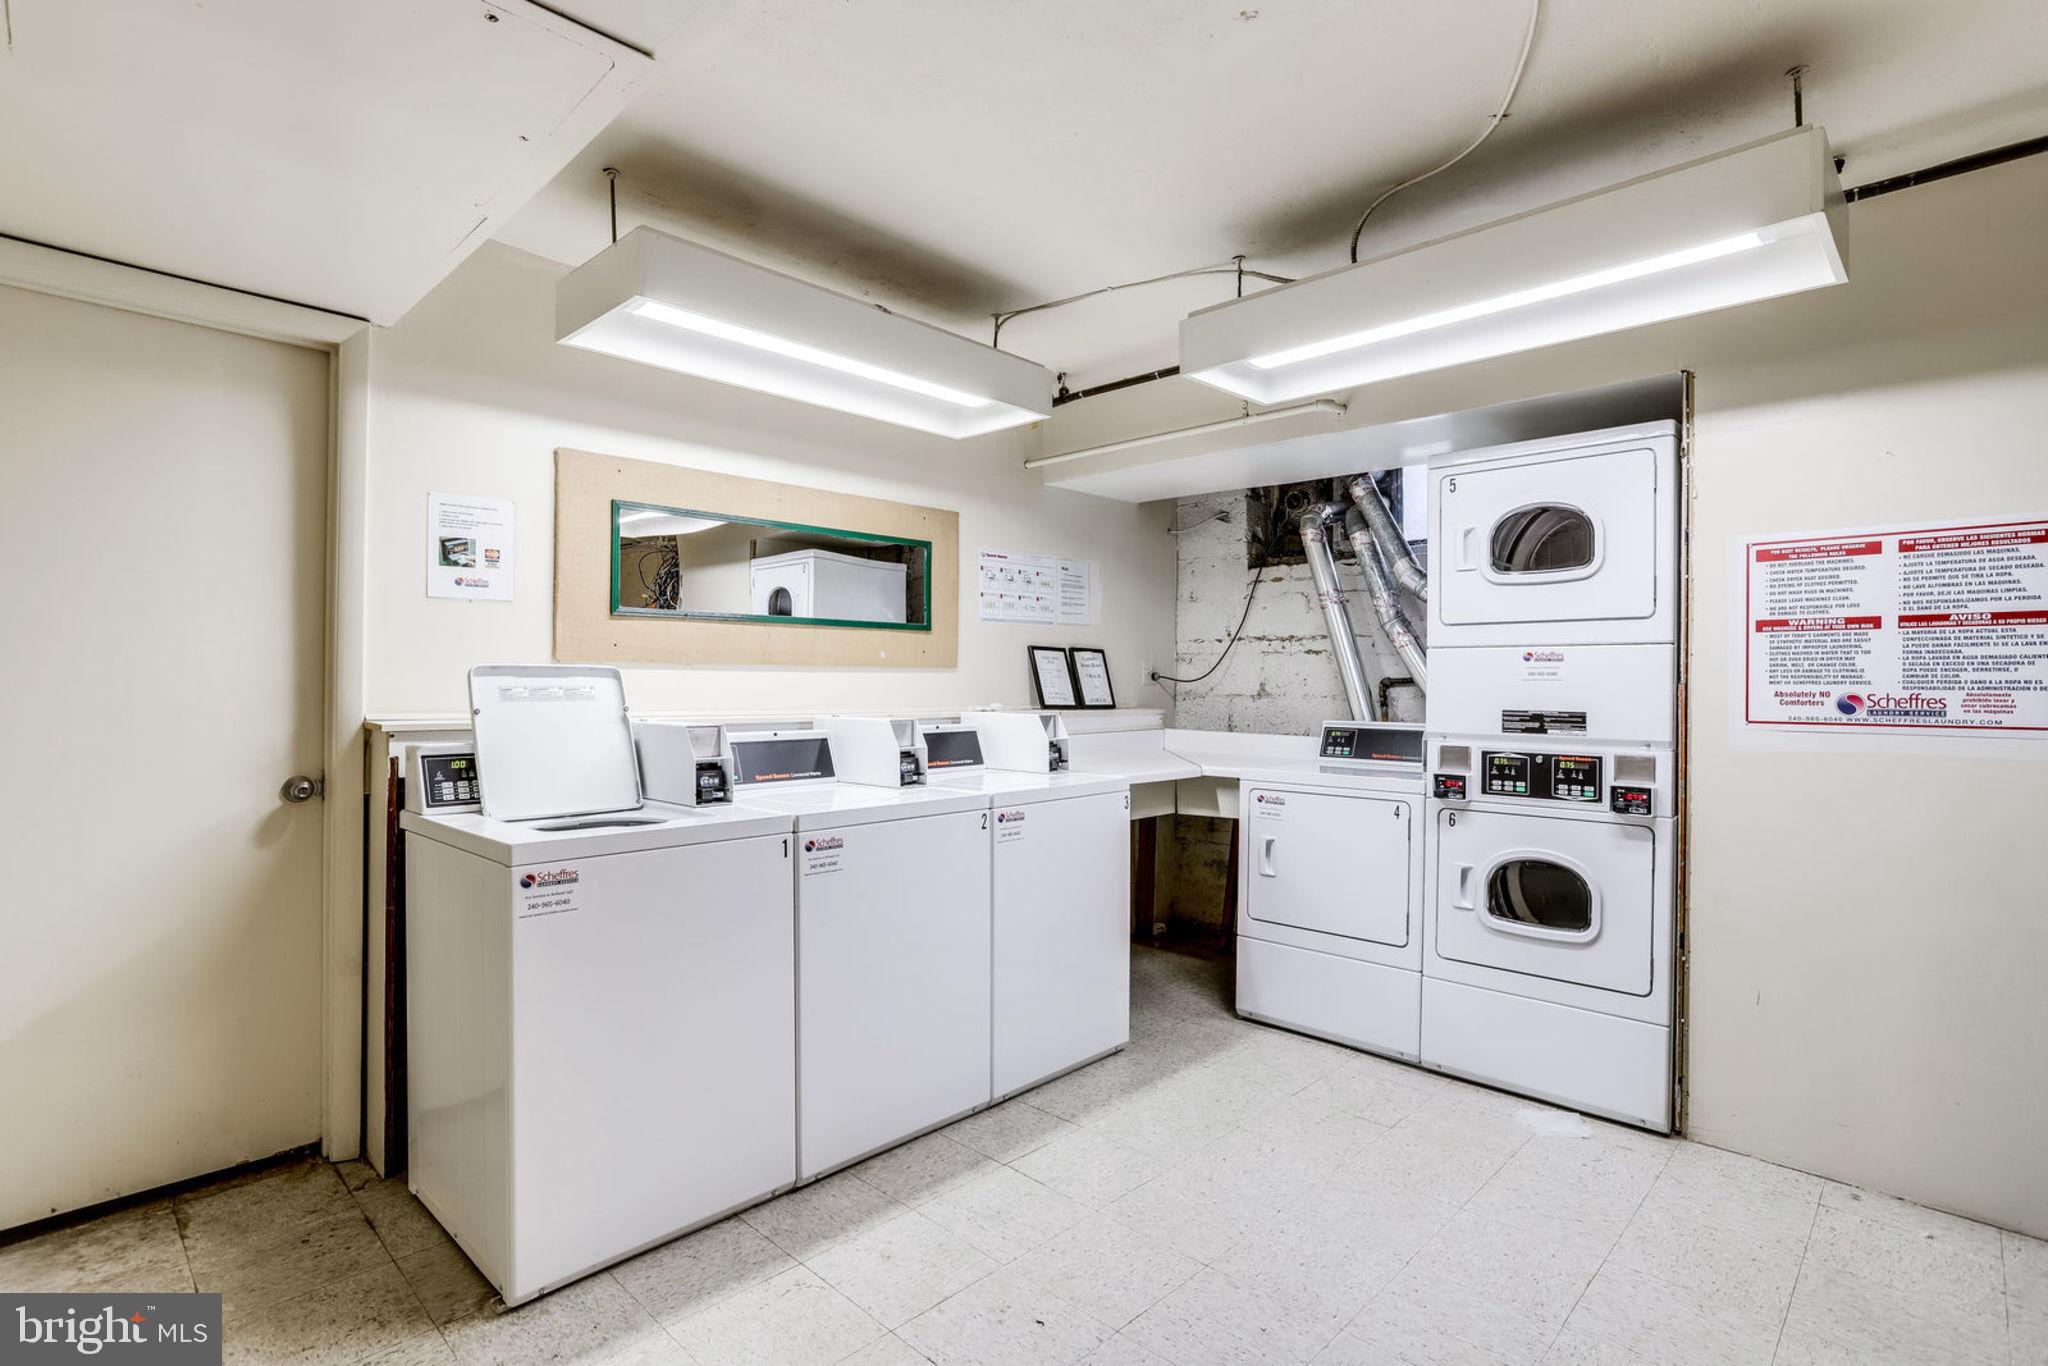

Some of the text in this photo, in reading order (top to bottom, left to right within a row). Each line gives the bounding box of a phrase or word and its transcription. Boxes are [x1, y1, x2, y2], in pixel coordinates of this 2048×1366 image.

[1450, 479, 1456, 493] 5
[1789, 618, 1845, 626] WARNING
[1949, 613, 1992, 621] AVISO
[1774, 691, 1816, 699] Absolutely
[1867, 693, 1947, 709] Scheffres
[1847, 717, 2003, 725] WWW.SCHEFFRESLAUNDRY.COM
[1124, 796, 1130, 810] 3
[1394, 805, 1400, 819] 4
[981, 814, 988, 830] 2
[1449, 812, 1456, 827] 6
[782, 839, 788, 858] 1
[528, 899, 571, 910] 240-965-6040
